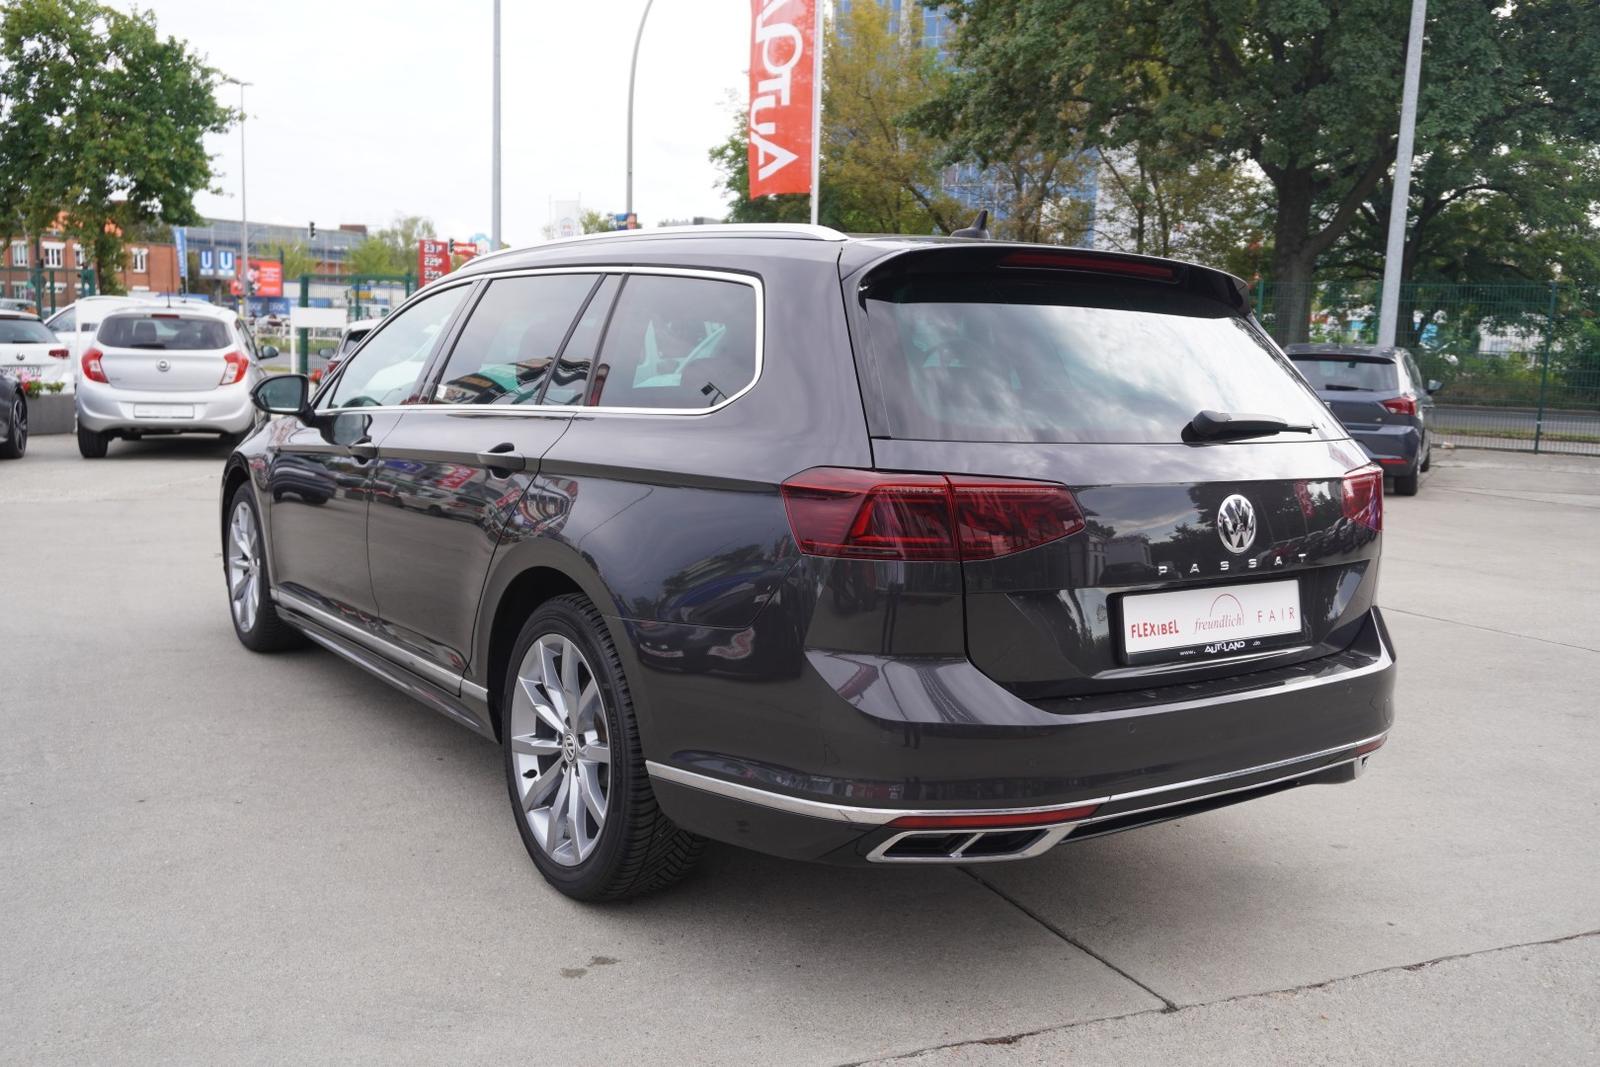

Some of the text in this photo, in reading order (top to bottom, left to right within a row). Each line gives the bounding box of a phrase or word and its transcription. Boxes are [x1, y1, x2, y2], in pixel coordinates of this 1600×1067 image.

[201, 250, 213, 269] U
[219, 251, 233, 269] U
[1158, 553, 1307, 576] PASSAT
[1130, 606, 1296, 639] FLEXIBEL freundlich FAIR
[1204, 640, 1246, 655] AUTOLAND
